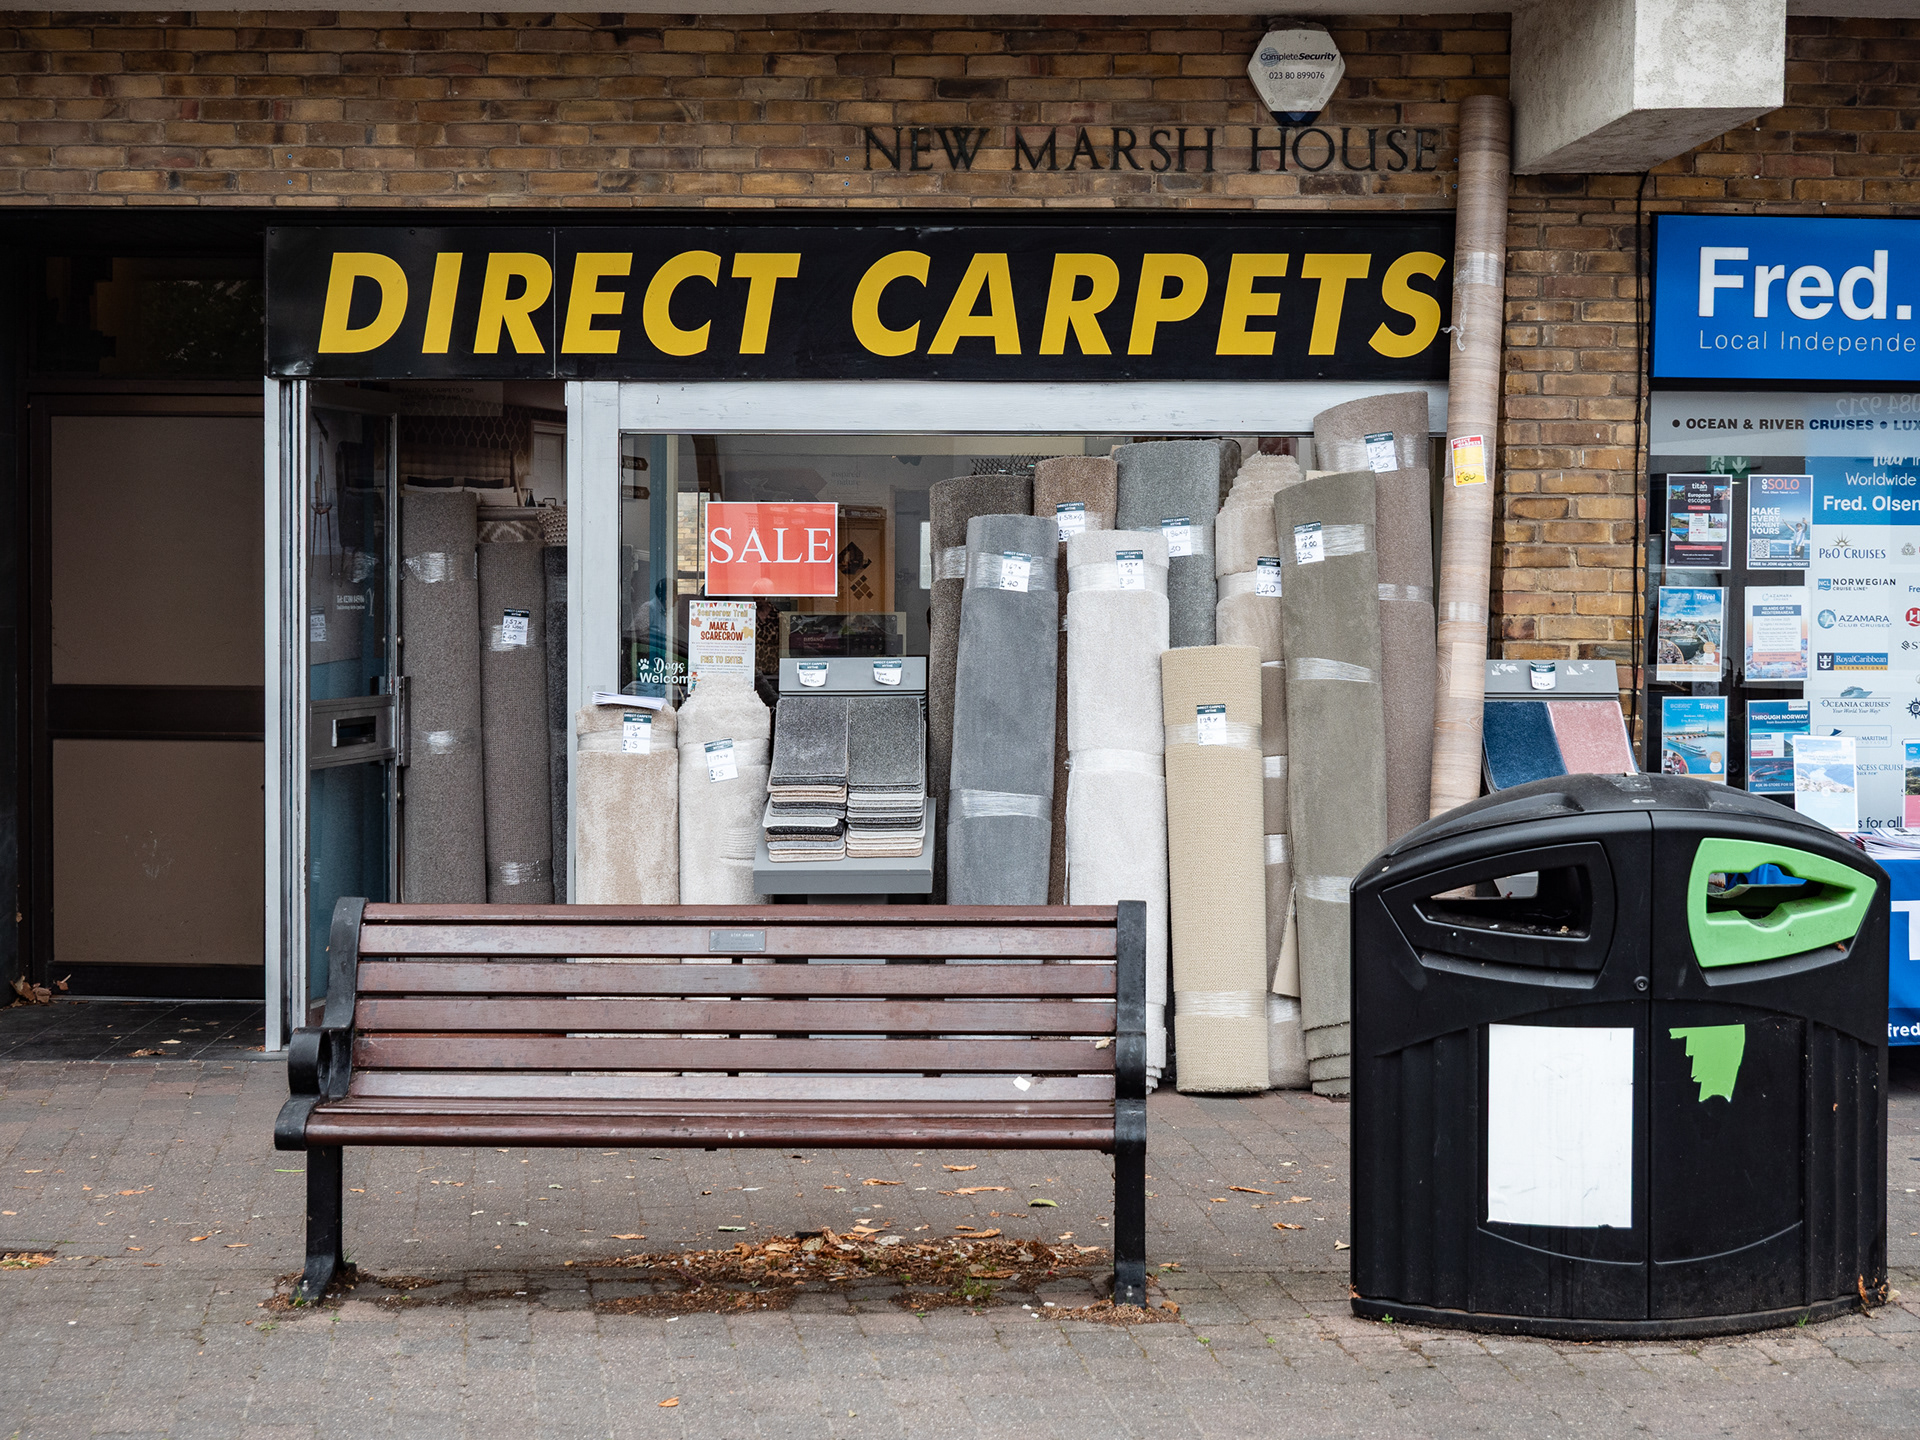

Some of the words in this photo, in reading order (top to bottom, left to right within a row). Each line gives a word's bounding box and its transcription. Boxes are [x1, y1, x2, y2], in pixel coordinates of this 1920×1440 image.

[1260, 52, 1336, 62] CompleteSecurity
[1268, 72, 1282, 80] 023
[1285, 72, 1295, 80] 80
[1296, 72, 1325, 80] 899076
[863, 126, 990, 172] NEW
[1013, 126, 1216, 173] MARSH
[1248, 126, 1438, 173] HOUSE
[1698, 246, 1912, 320] Fred.
[318, 251, 802, 356] DIRECT
[851, 251, 1446, 357] CARPETS
[1700, 330, 1768, 350] Local
[1780, 330, 1917, 356] Independe
[1686, 418, 1738, 430] OCEAN
[1742, 419, 1754, 430] &
[1759, 419, 1804, 430] RIVER
[1809, 420, 1874, 431] CRUISES
[1768, 478, 1800, 490] SOLO
[1845, 472, 1917, 486] Worldwide
[1824, 496, 1867, 511] Fred.
[710, 527, 833, 564] SALE
[1819, 548, 1840, 559] P&O
[1844, 548, 1886, 559] CRUISES
[697, 609, 731, 617] Scarecrow
[709, 622, 728, 630] MAKE
[731, 622, 735, 631] A
[700, 631, 743, 641] SCARECROW
[700, 655, 714, 663] FREE
[715, 656, 723, 664] TO
[725, 656, 743, 664] ENTER
[654, 657, 685, 675] Dogs
[639, 672, 689, 684] Welcom
[1866, 816, 1882, 828] for
[1887, 816, 1902, 828] all
